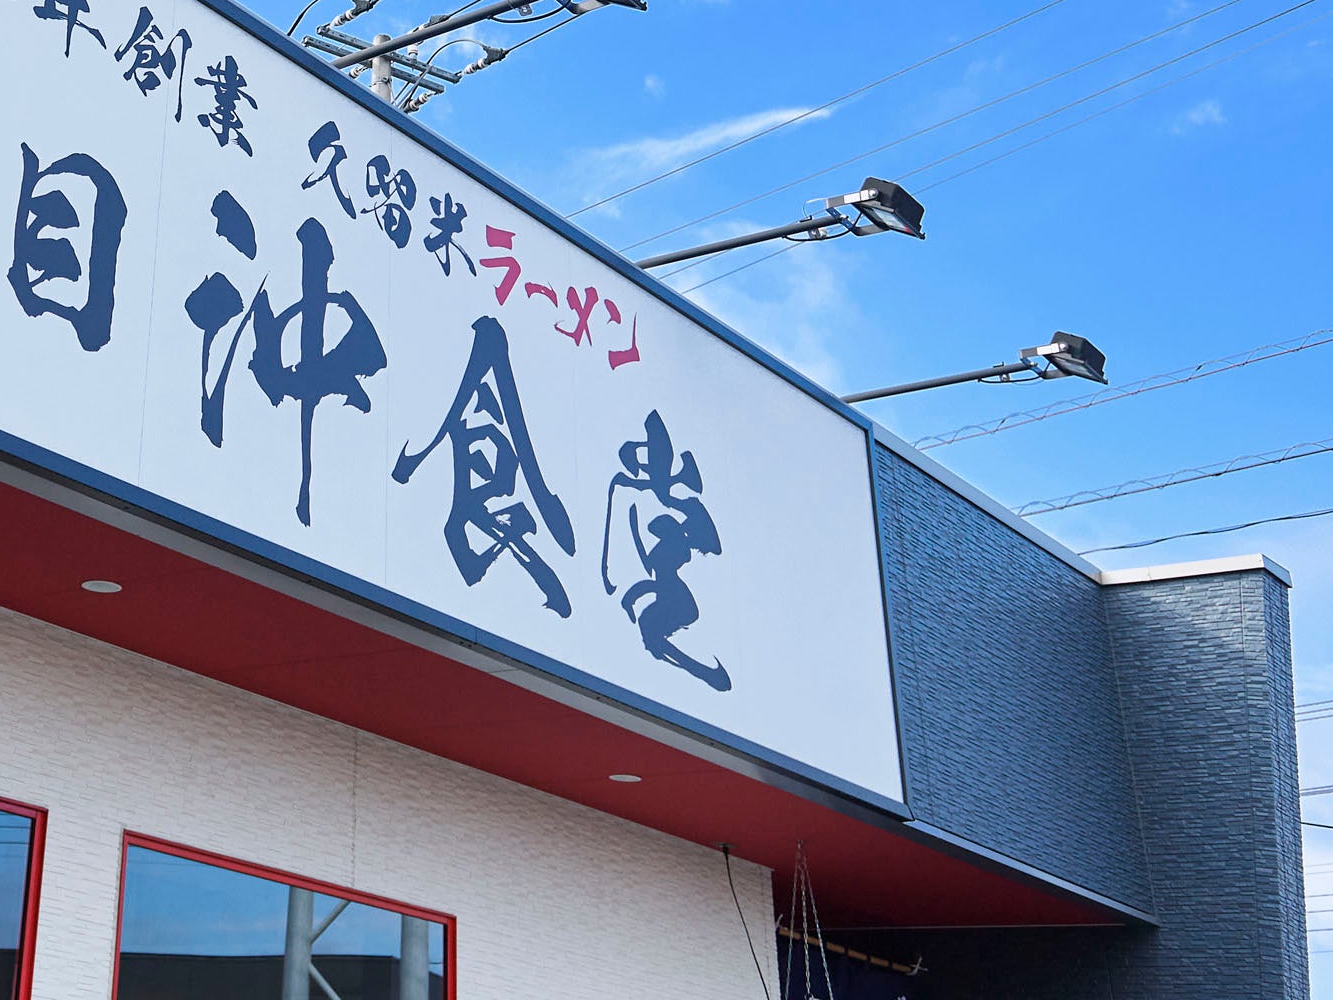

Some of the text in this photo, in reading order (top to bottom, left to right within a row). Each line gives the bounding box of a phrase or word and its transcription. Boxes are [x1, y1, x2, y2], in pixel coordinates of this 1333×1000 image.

[301, 120, 641, 370] 久留米ラーメン
